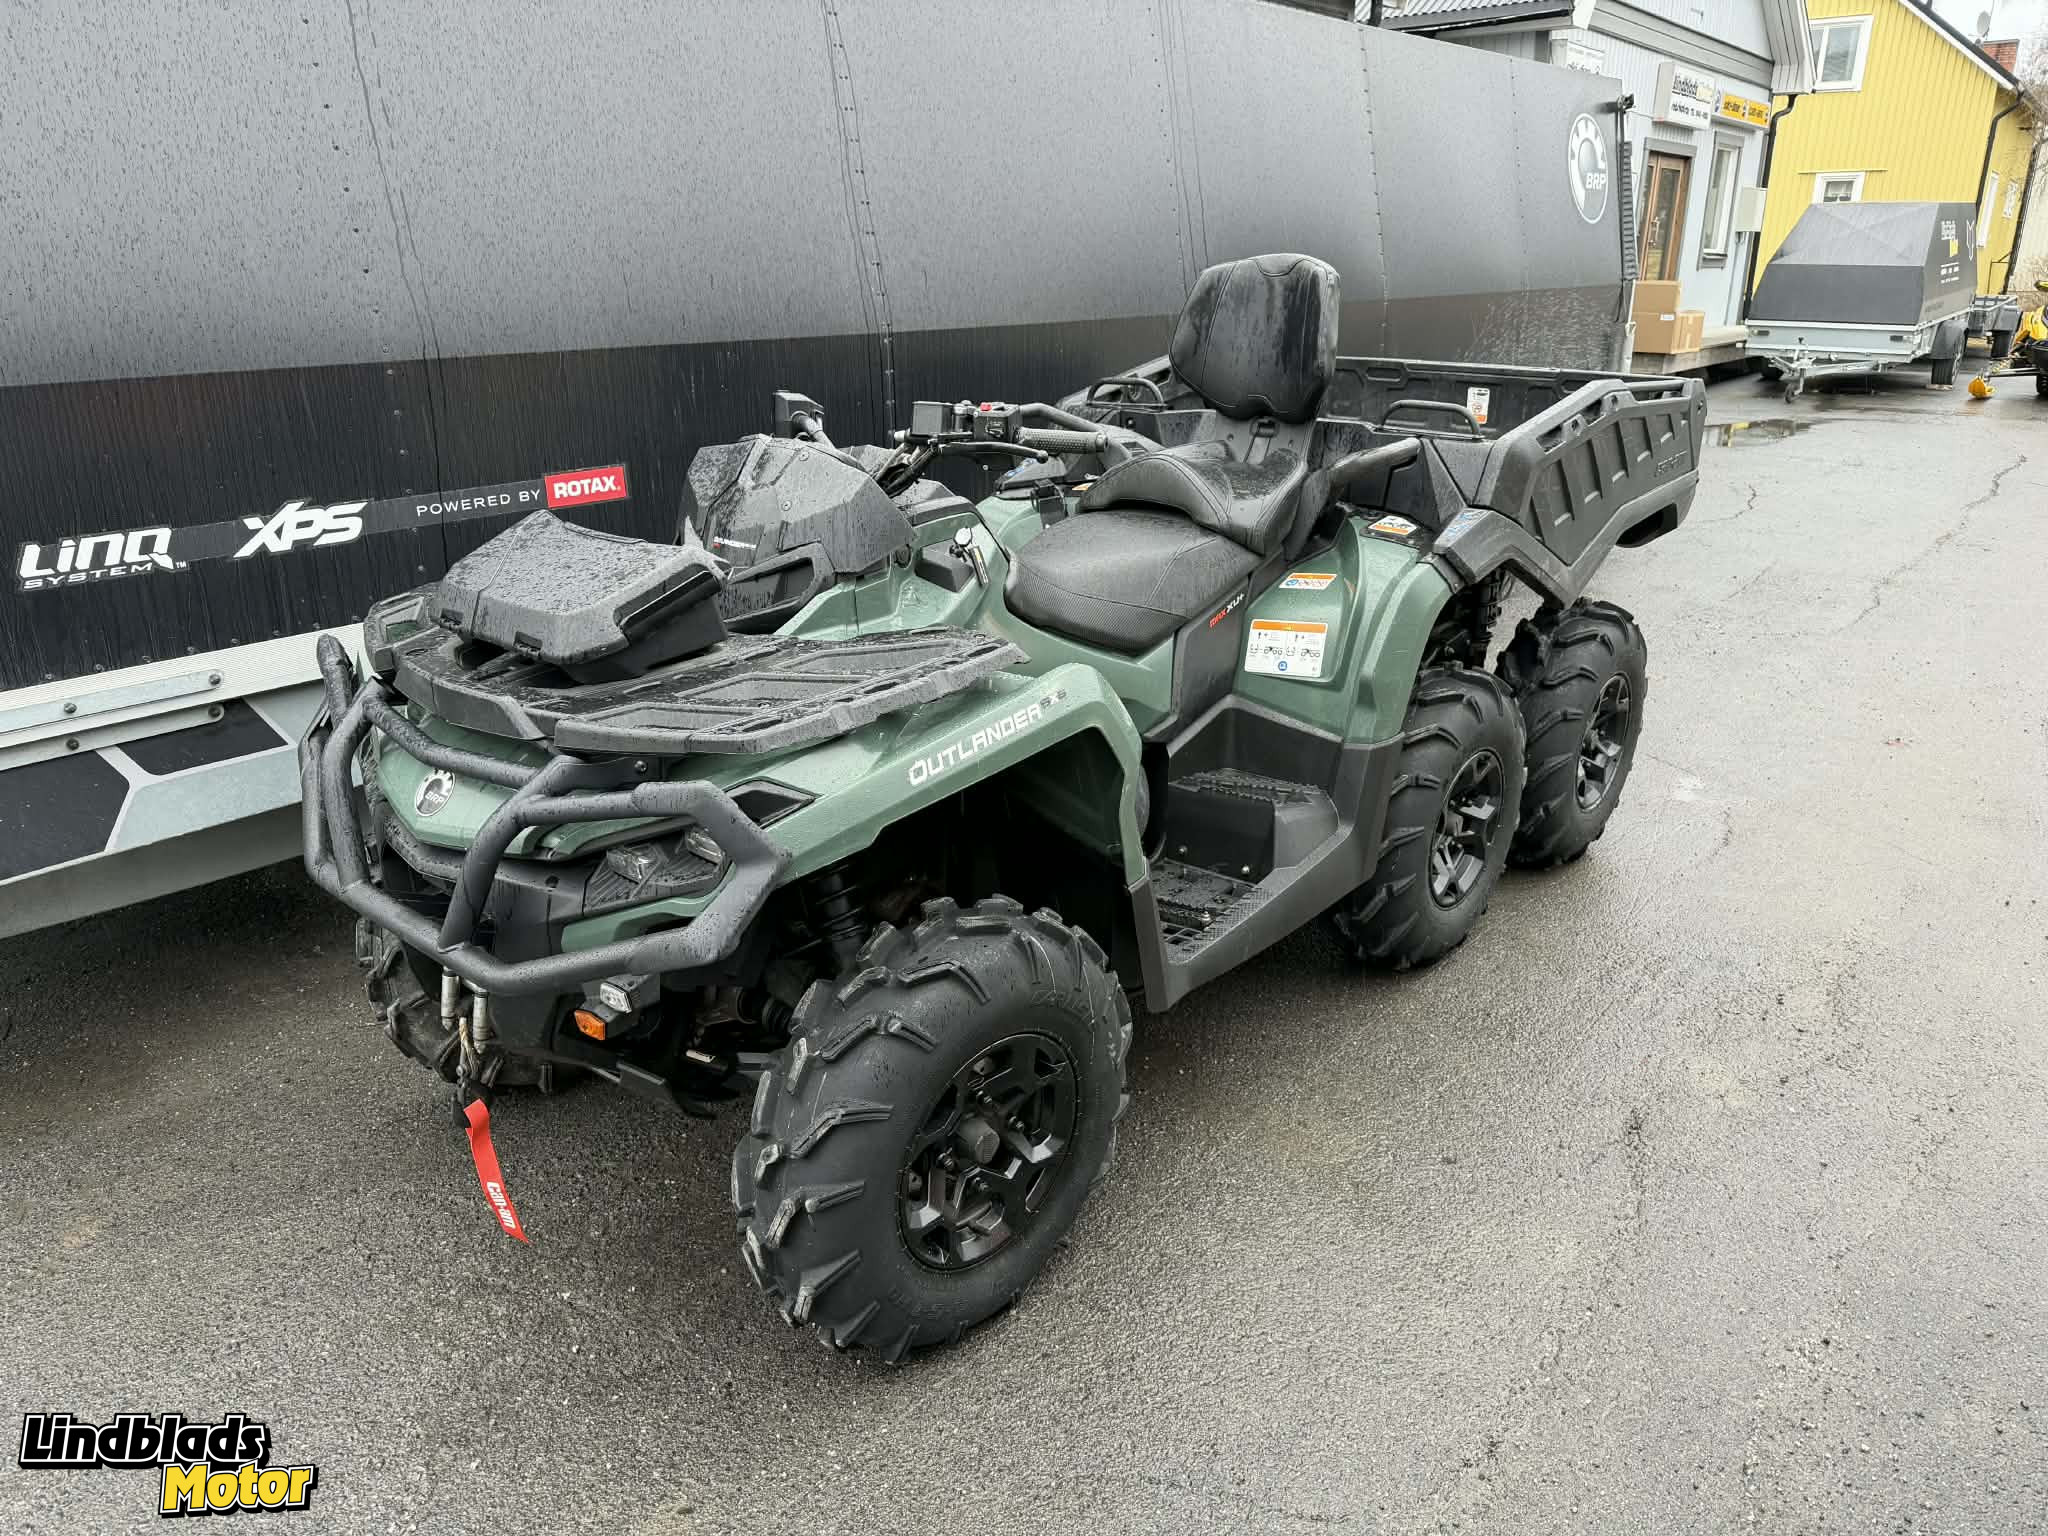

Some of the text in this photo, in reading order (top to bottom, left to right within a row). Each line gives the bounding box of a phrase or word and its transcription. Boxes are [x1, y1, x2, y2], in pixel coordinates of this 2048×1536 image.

[1586, 172, 1606, 190] BRP
[416, 476, 617, 517] POWERED BY ROTAX
[233, 501, 367, 558] XPS
[23, 562, 153, 590] SYSTEM
[908, 703, 1042, 786] OUTLANDER
[425, 791, 446, 805] BRP
